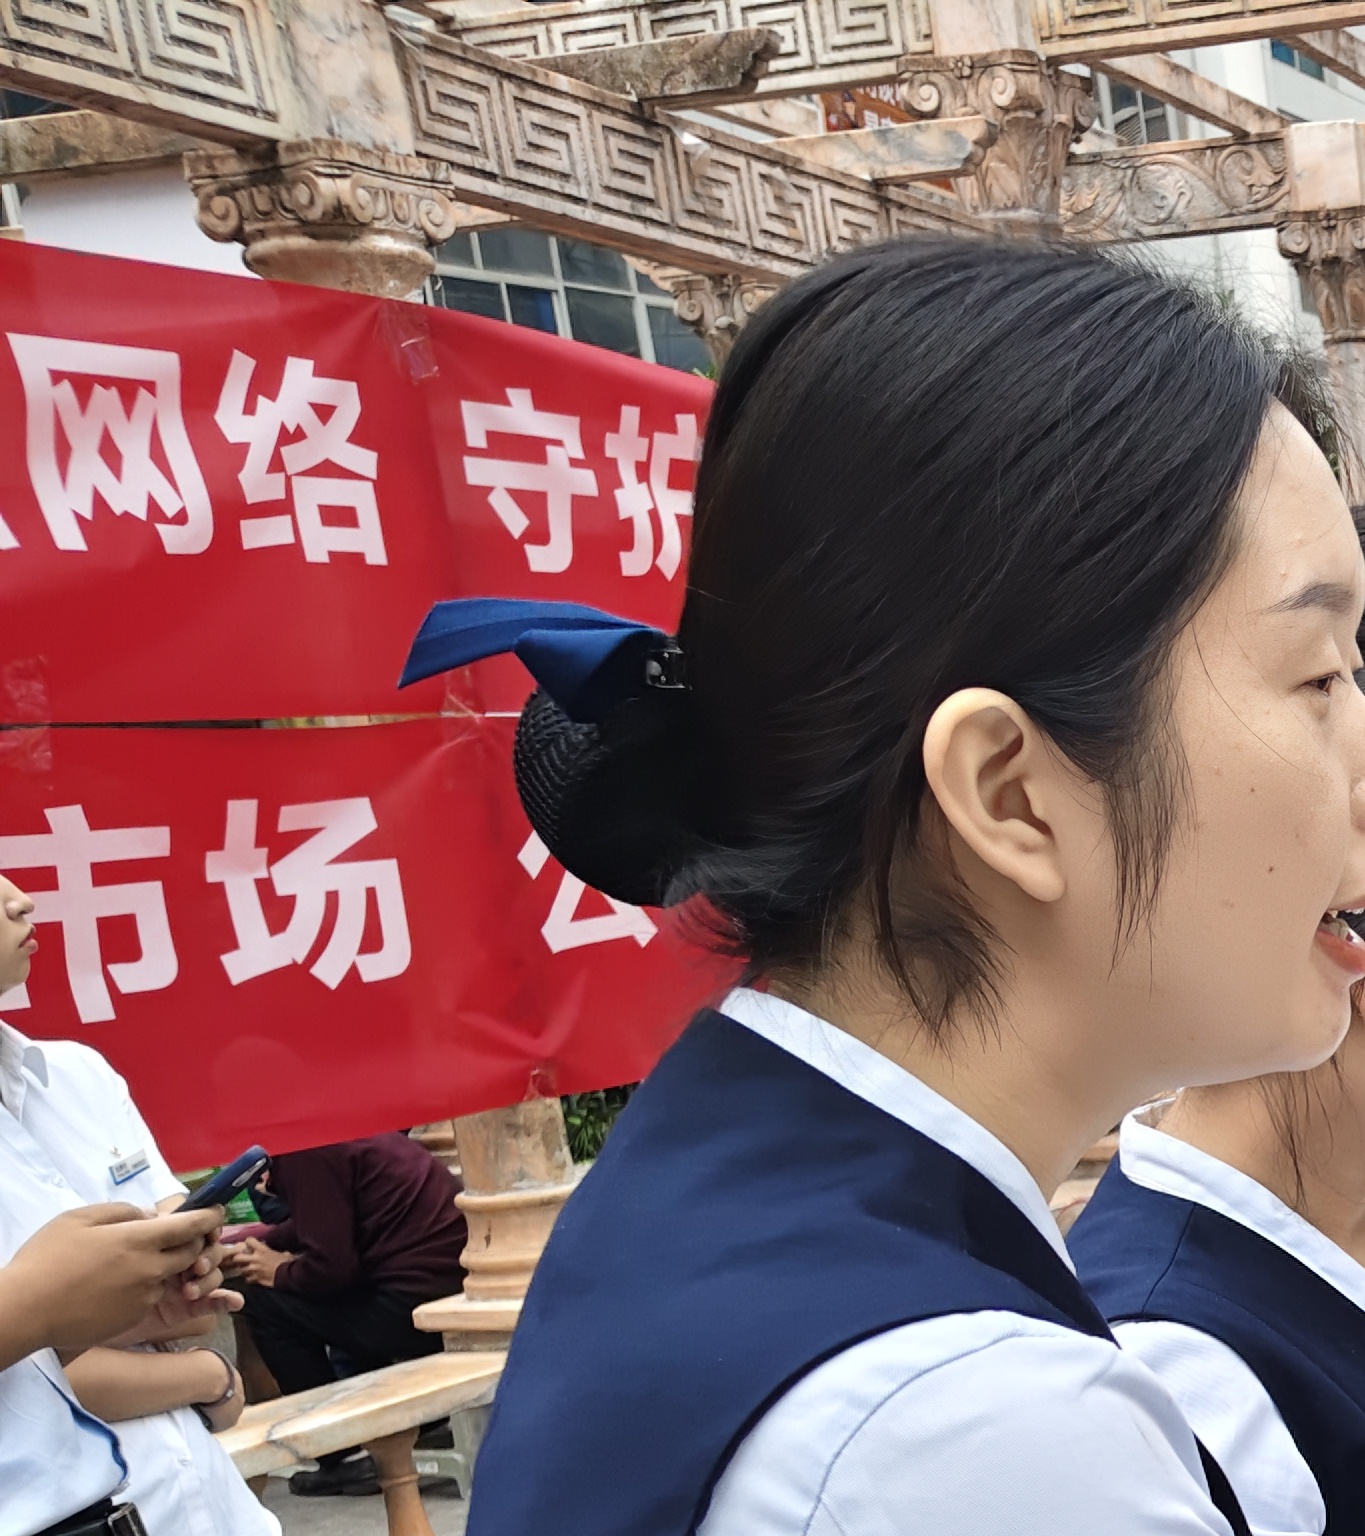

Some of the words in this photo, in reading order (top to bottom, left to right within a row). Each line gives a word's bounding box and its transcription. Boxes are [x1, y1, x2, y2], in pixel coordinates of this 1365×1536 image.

[0, 331, 389, 567] 网络
[460, 388, 704, 582] 守护
[0, 796, 413, 1025] 市场
